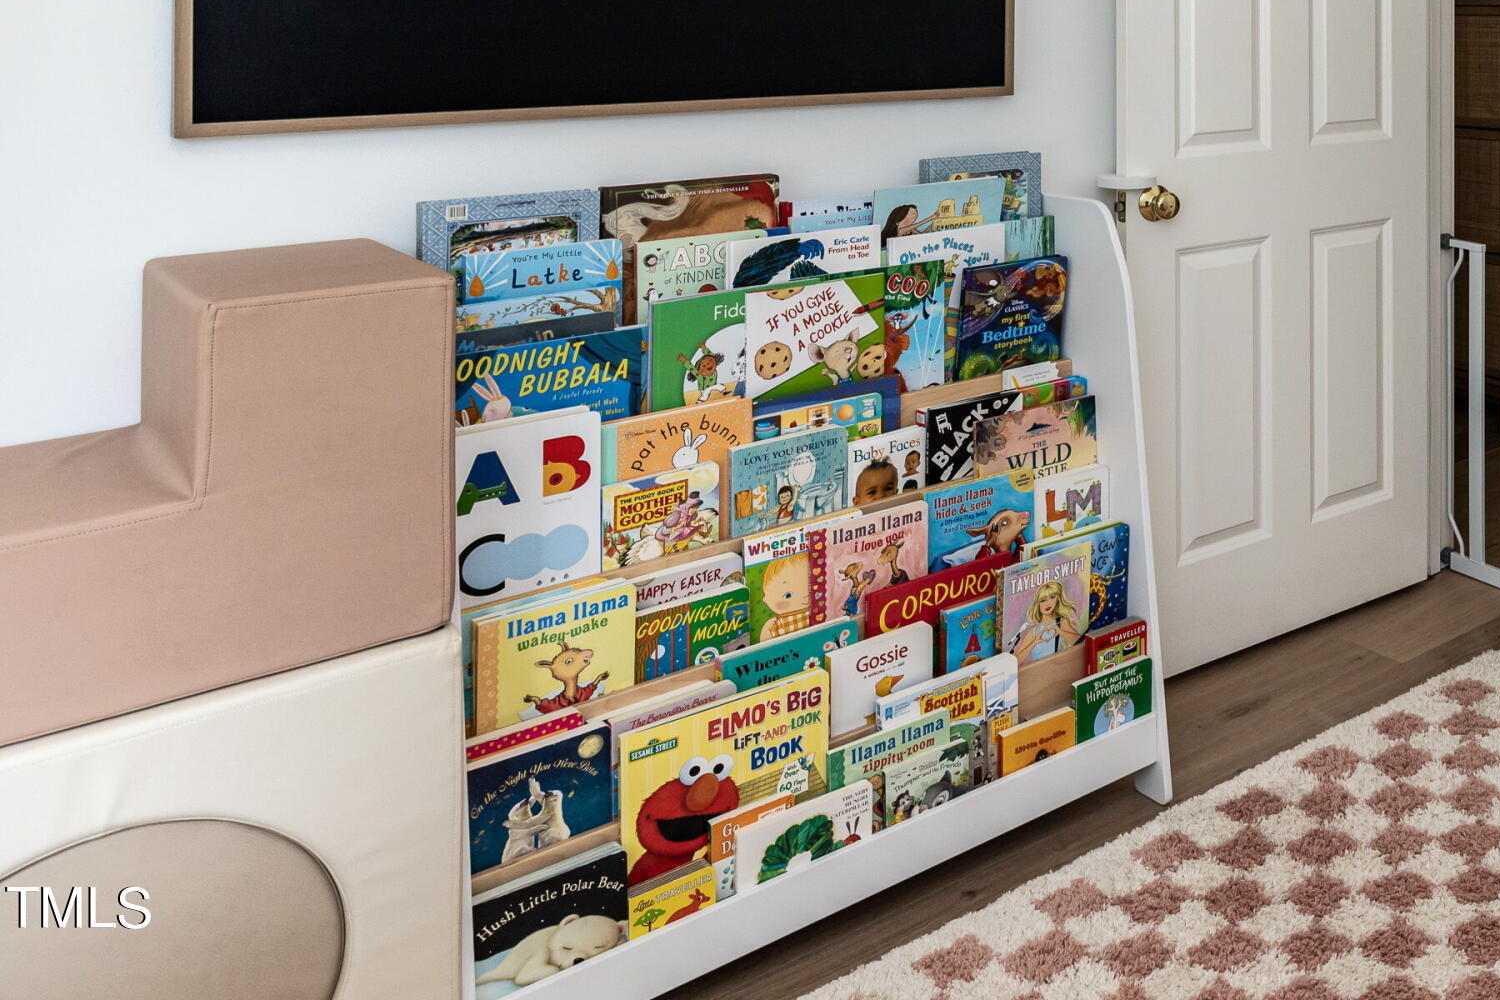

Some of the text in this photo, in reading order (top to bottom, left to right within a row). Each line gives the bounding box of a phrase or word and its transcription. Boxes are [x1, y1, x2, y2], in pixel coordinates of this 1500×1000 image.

[828, 243, 870, 254] From Head
[834, 236, 870, 246] Eric Carle
[922, 242, 940, 255] the
[942, 237, 975, 253] Places
[512, 249, 582, 264] You're My Little
[963, 252, 990, 267] You'll
[511, 263, 584, 290] Latke
[766, 286, 837, 333] IF YOU GIVE
[792, 299, 845, 337] A MOUSE
[1001, 311, 1032, 325] my first
[1004, 303, 1030, 314] CLASSICS
[798, 309, 854, 353] A COOKIE
[981, 321, 1047, 345] Bedtime
[993, 334, 1034, 350] storybook
[456, 340, 586, 383] OODNIGHT
[518, 358, 630, 398] BUBBALA
[560, 390, 580, 400] Joyful
[582, 387, 604, 396] Parody
[630, 439, 656, 473] pat
[660, 421, 690, 440] the
[931, 403, 990, 470] BLACK
[1032, 440, 1048, 449] THE
[744, 454, 770, 466] LOVE
[772, 446, 794, 459] YOU
[796, 438, 839, 454] FOREVER
[853, 438, 921, 464] Baby Faces
[1006, 442, 1072, 470] WILD
[456, 450, 521, 517] A
[620, 484, 685, 506] THE PUDGY BOOK OF
[620, 492, 685, 517] MOTHER
[934, 488, 994, 510] llama llama
[935, 498, 992, 520] hide & seek
[619, 505, 674, 528] GOOSE
[832, 510, 923, 546] llama llama
[748, 536, 797, 557] Where
[772, 546, 797, 558] Belly
[861, 537, 884, 552] love
[886, 530, 905, 546] you
[1010, 568, 1050, 595] TAYLOR
[1054, 557, 1086, 580] SWIFT
[636, 581, 678, 602] HAPPY
[506, 611, 567, 640] llama
[573, 594, 630, 621] llama
[636, 598, 734, 640] GOODNIGHT
[692, 616, 744, 644] MOON
[517, 617, 609, 652] wakey-wake
[1110, 624, 1146, 644] TRAVELLER
[734, 649, 800, 679] Where's
[856, 644, 909, 673] Gossie
[757, 672, 780, 686] the
[1094, 666, 1138, 692] BUT NOT THE
[924, 684, 979, 714] Scottish
[630, 718, 646, 730] The
[707, 700, 781, 742] ELMO'S
[630, 746, 654, 761] SESAME
[655, 740, 677, 754] STREET
[750, 735, 804, 772] BOOK
[850, 717, 944, 765] llama llama
[862, 737, 936, 775] zippity-zoom
[779, 781, 792, 793] 60
[784, 769, 800, 779] Over
[470, 758, 600, 820] On the Night You Were Born
[830, 801, 869, 820] CATERPILLAR
[656, 872, 712, 904] TRAVELLER
[476, 876, 625, 943] Hush Little Polar Bear
